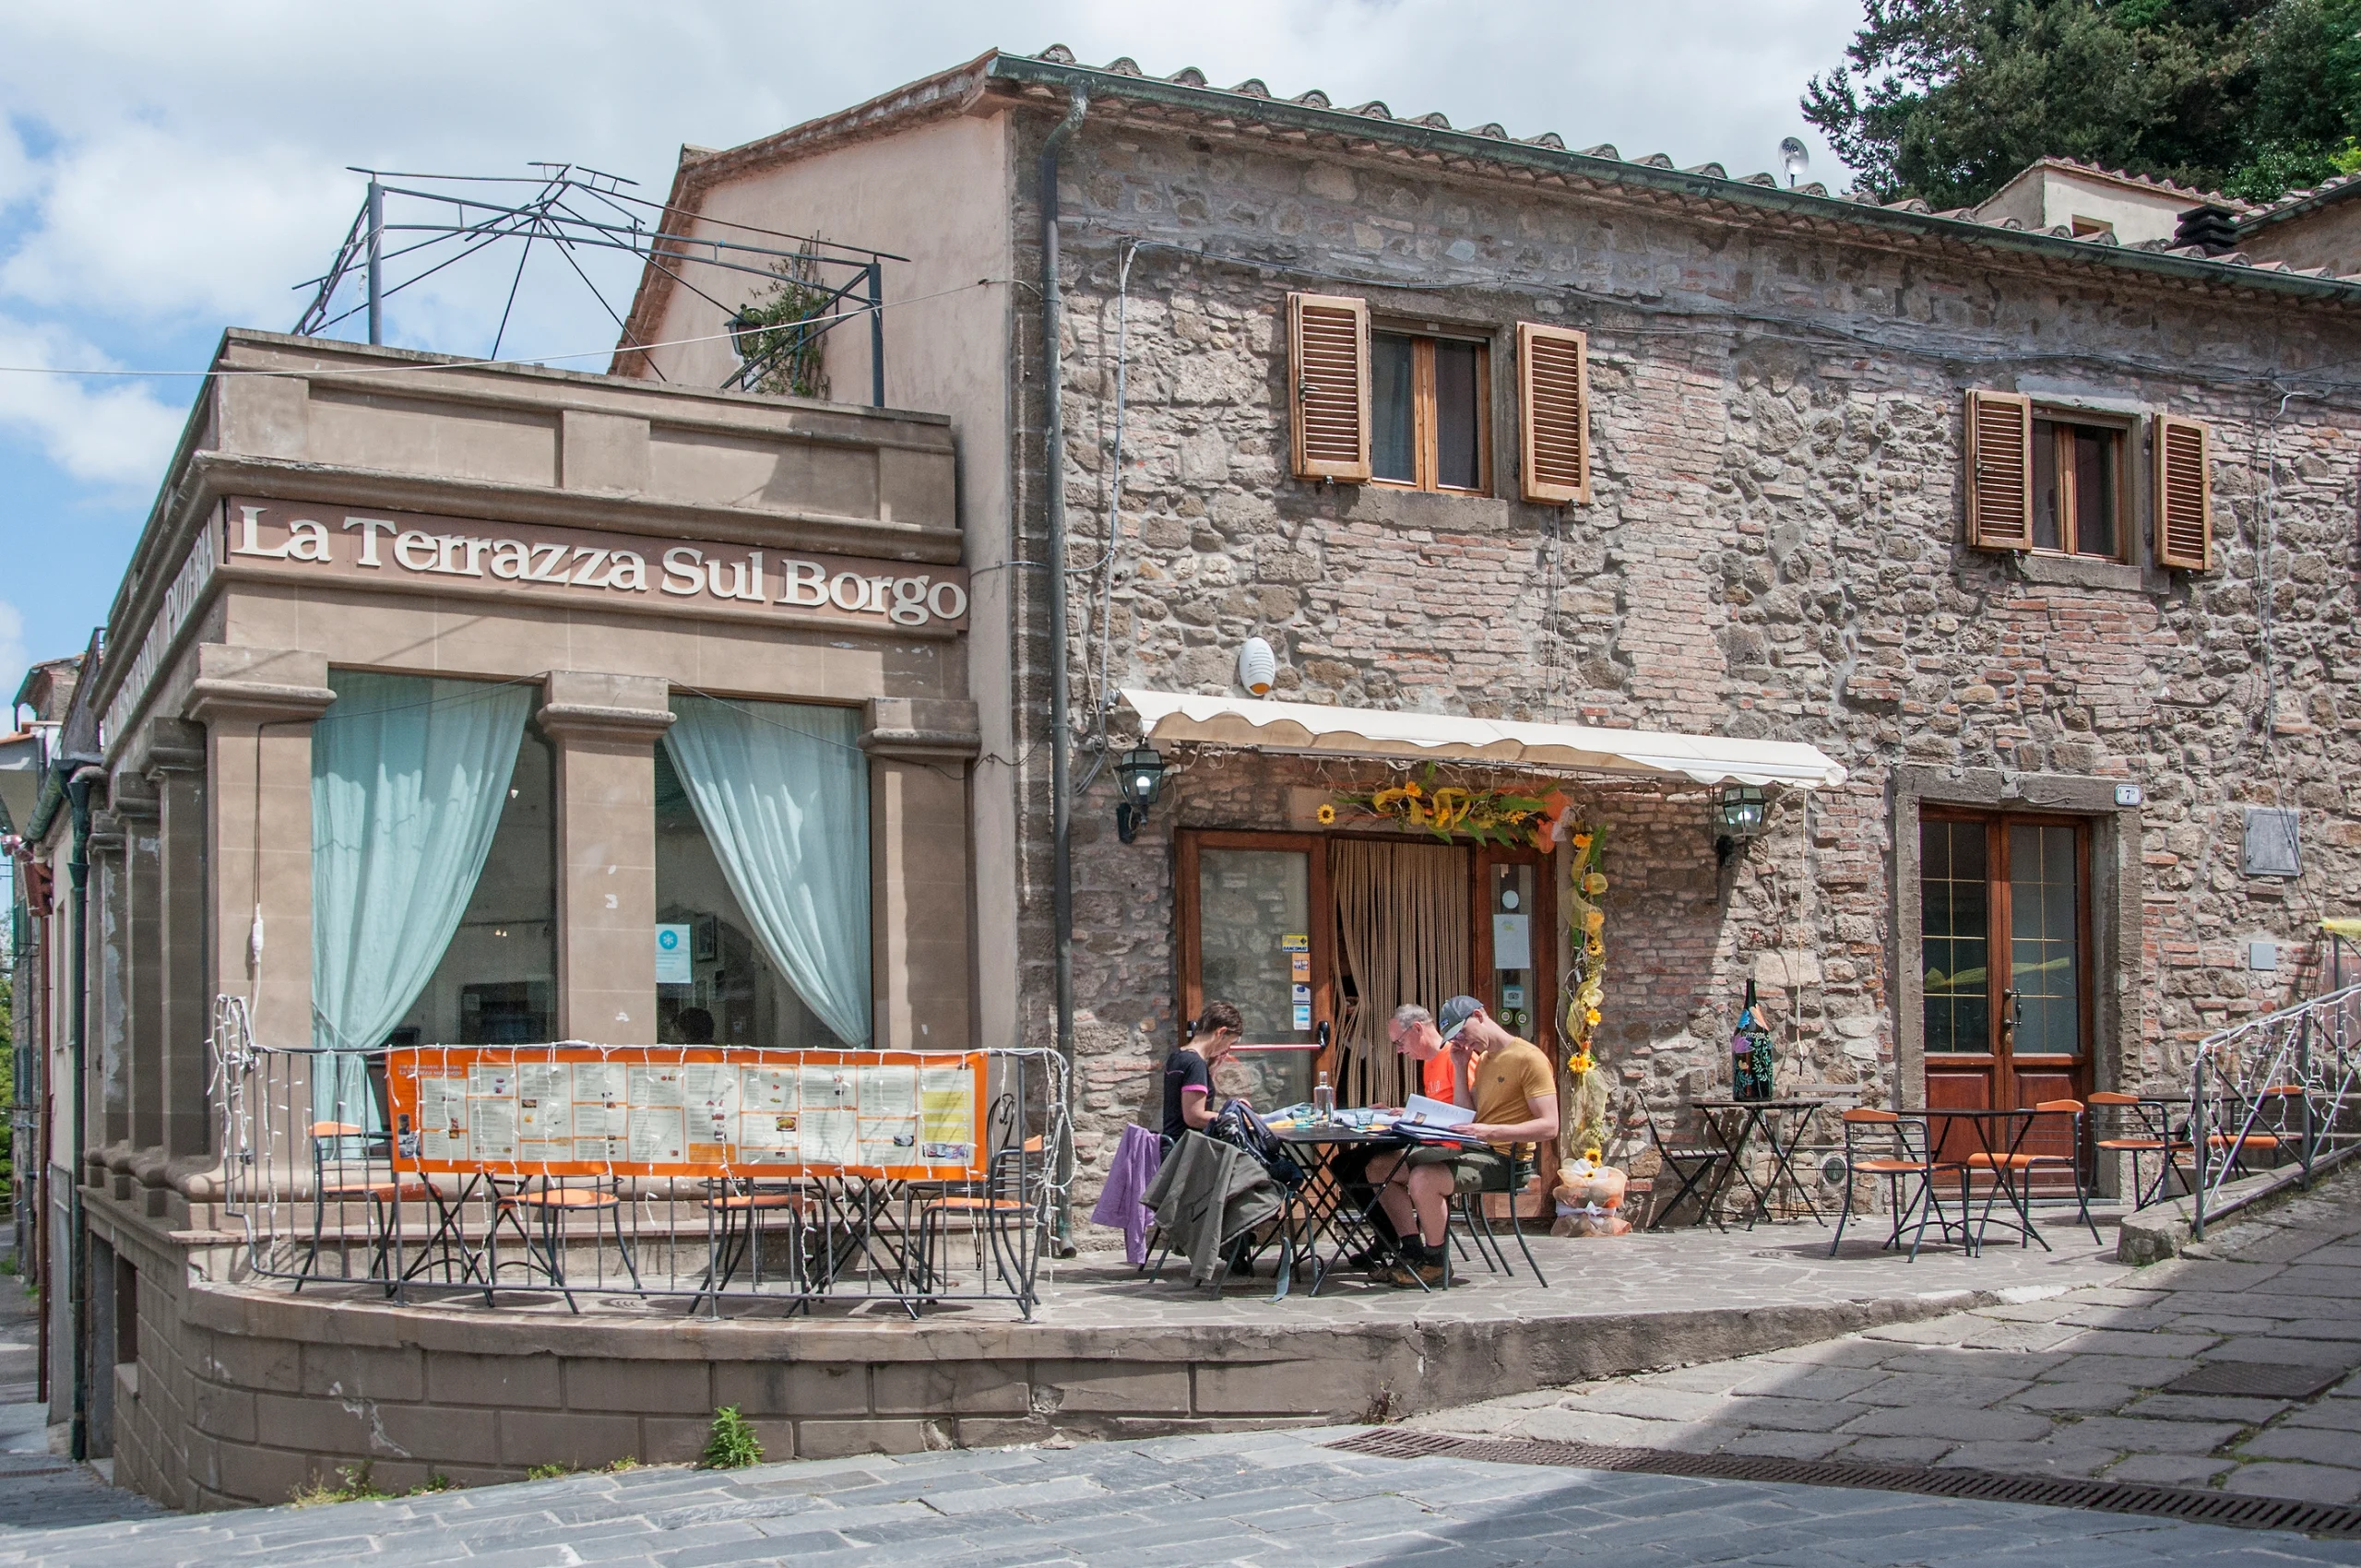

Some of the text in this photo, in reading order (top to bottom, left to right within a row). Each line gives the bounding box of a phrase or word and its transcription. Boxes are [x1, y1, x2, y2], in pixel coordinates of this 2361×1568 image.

[165, 517, 215, 645] PIZZERIA
[231, 505, 967, 626] La Terrazza Sul Borgo
